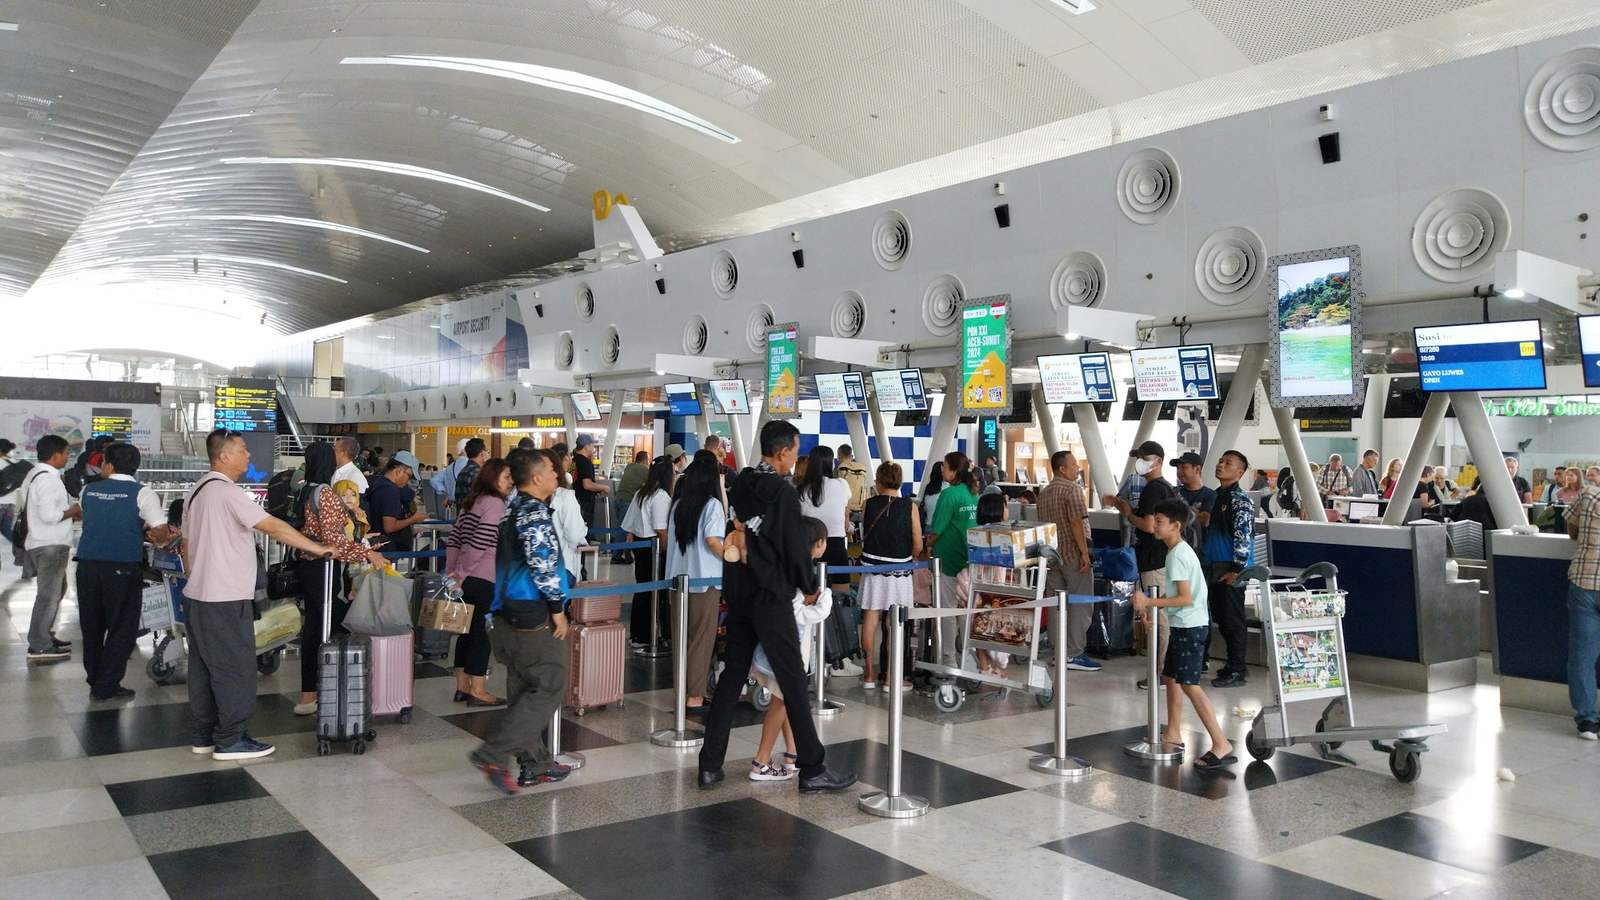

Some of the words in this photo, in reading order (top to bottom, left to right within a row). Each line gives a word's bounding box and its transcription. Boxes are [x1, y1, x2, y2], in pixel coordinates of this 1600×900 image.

[453, 319, 470, 336] AIRPORT
[470, 315, 490, 333] SECURITY
[978, 325, 988, 336] XXI
[1418, 333, 1440, 342] Susi
[967, 347, 981, 358] 2024
